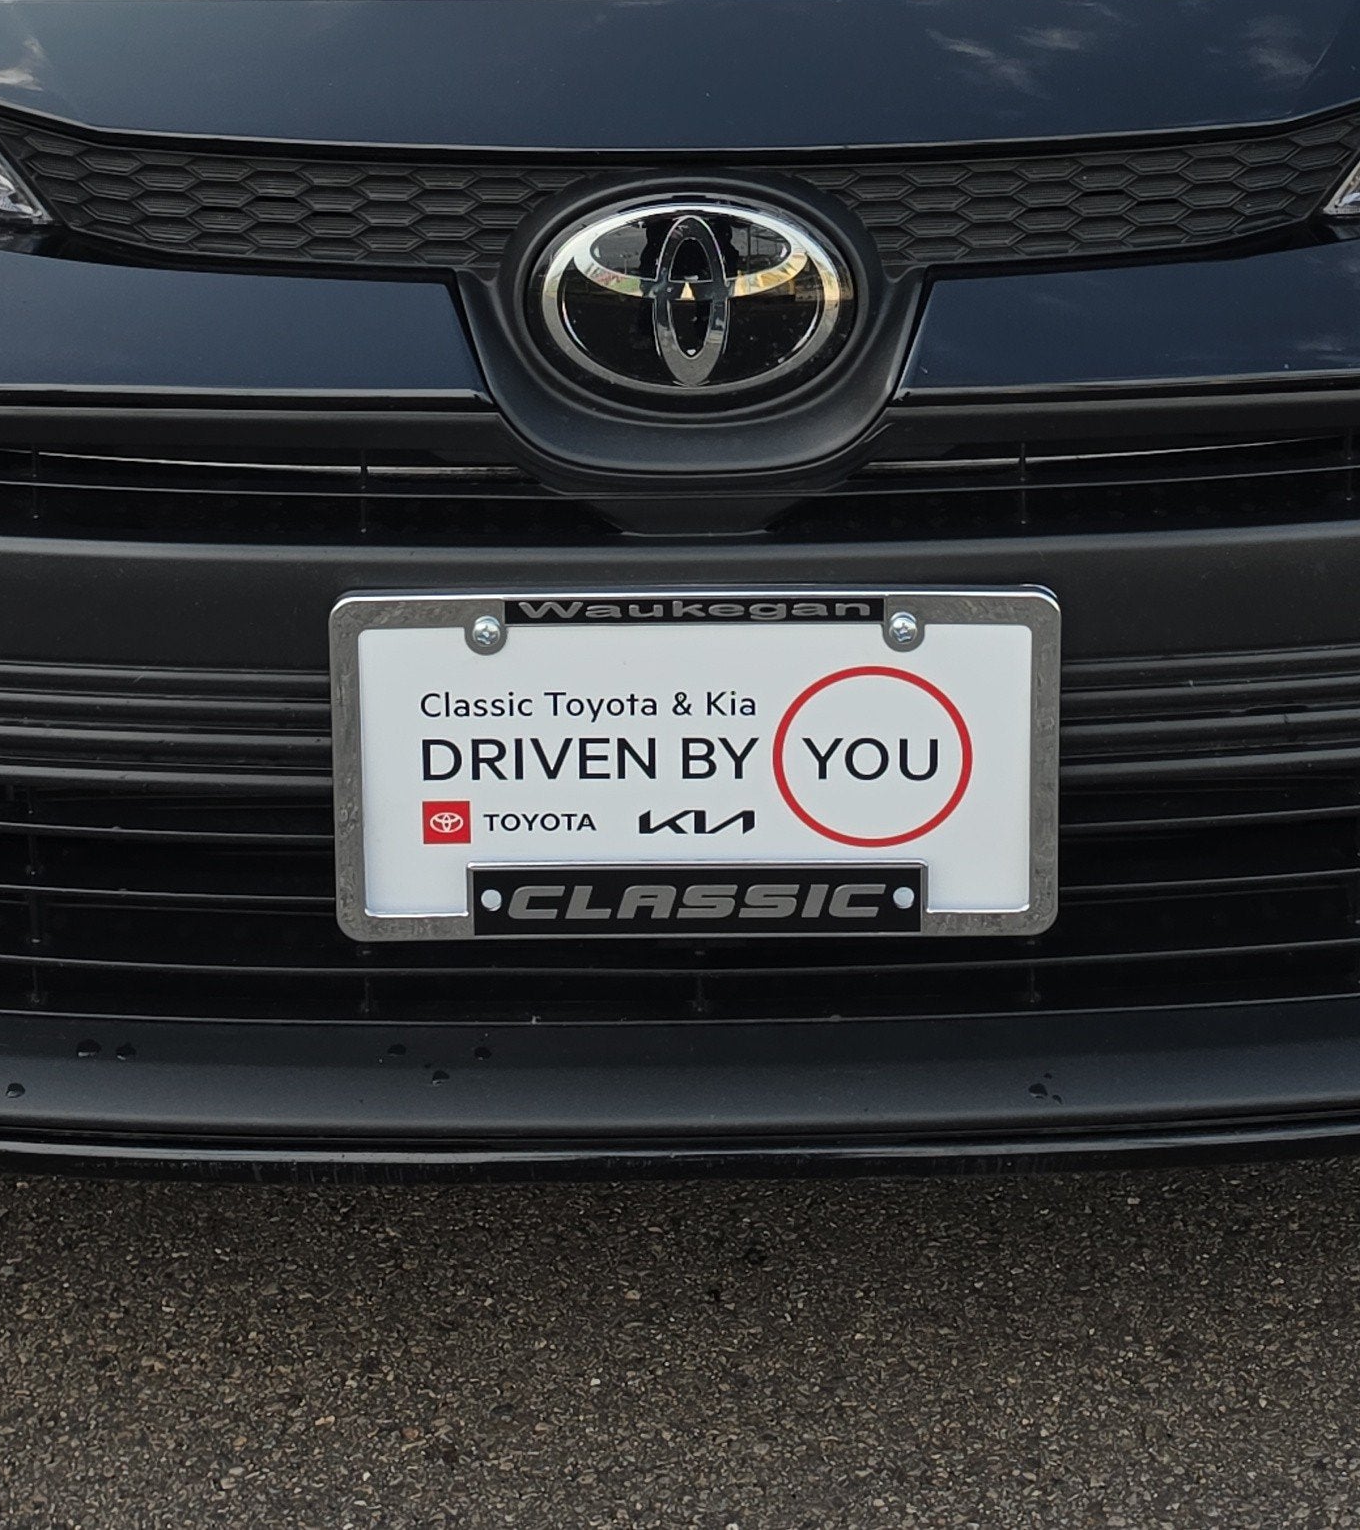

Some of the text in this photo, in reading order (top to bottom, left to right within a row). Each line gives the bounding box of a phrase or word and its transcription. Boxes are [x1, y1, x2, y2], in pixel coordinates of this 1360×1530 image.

[518, 601, 871, 621] Waukegan
[420, 690, 757, 723] Classic Toyota & Kia
[421, 737, 939, 782] DRIVEN BY YOU
[483, 812, 597, 833] TOYOTA
[506, 882, 887, 921] CLASSIC
